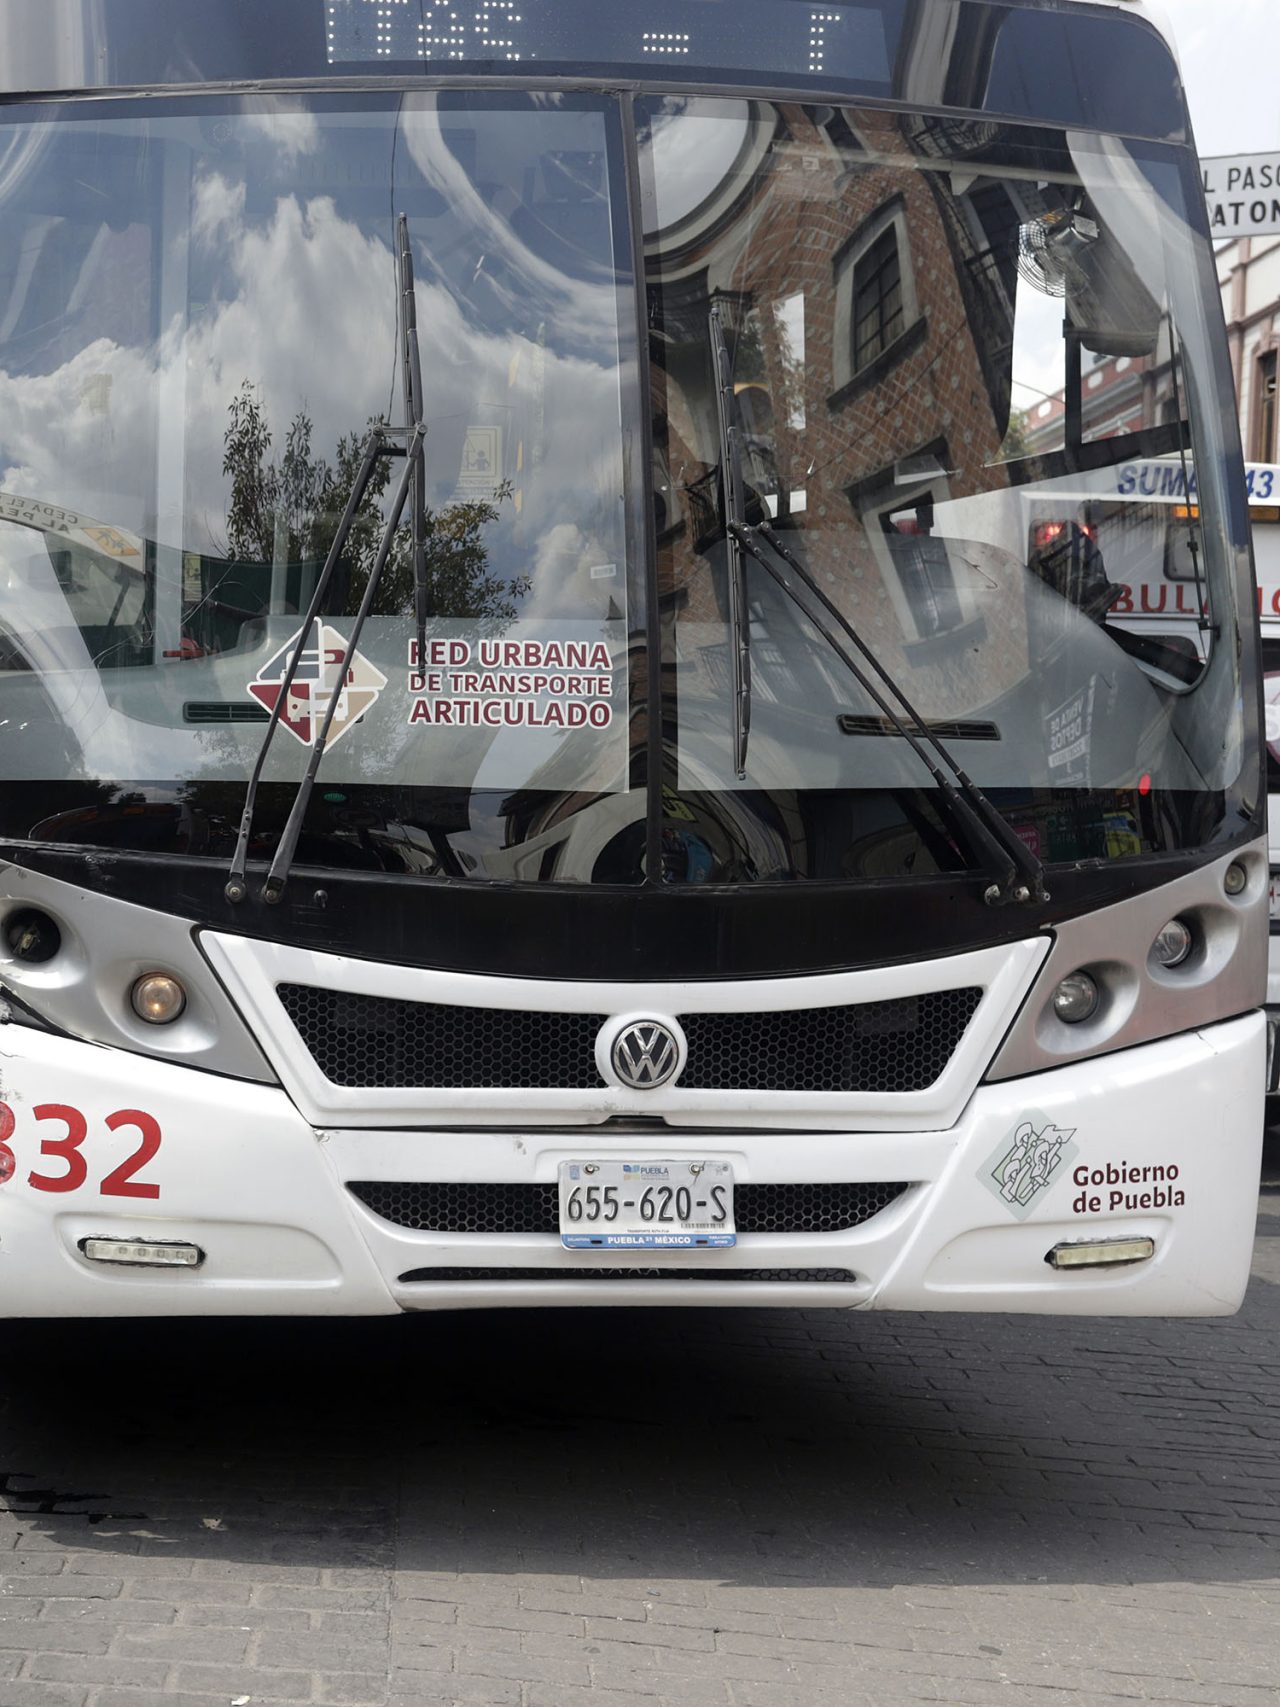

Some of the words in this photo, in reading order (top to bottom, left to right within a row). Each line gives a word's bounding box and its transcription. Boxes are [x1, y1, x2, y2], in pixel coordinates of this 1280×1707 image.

[480, 641, 611, 669] URBANA
[410, 673, 442, 692] DE
[449, 673, 611, 695] TRANSPORTE
[409, 699, 611, 728] ARTICULADO
[640, 1167, 669, 1175] PUEBLA
[1072, 1160, 1179, 1187] Gobierno
[567, 1185, 727, 1222] 655-620-S
[1072, 1190, 1102, 1214] de
[1109, 1185, 1185, 1212] Puebla
[607, 1236, 645, 1245] PUEBLA
[654, 1235, 692, 1245] MÉXICO
